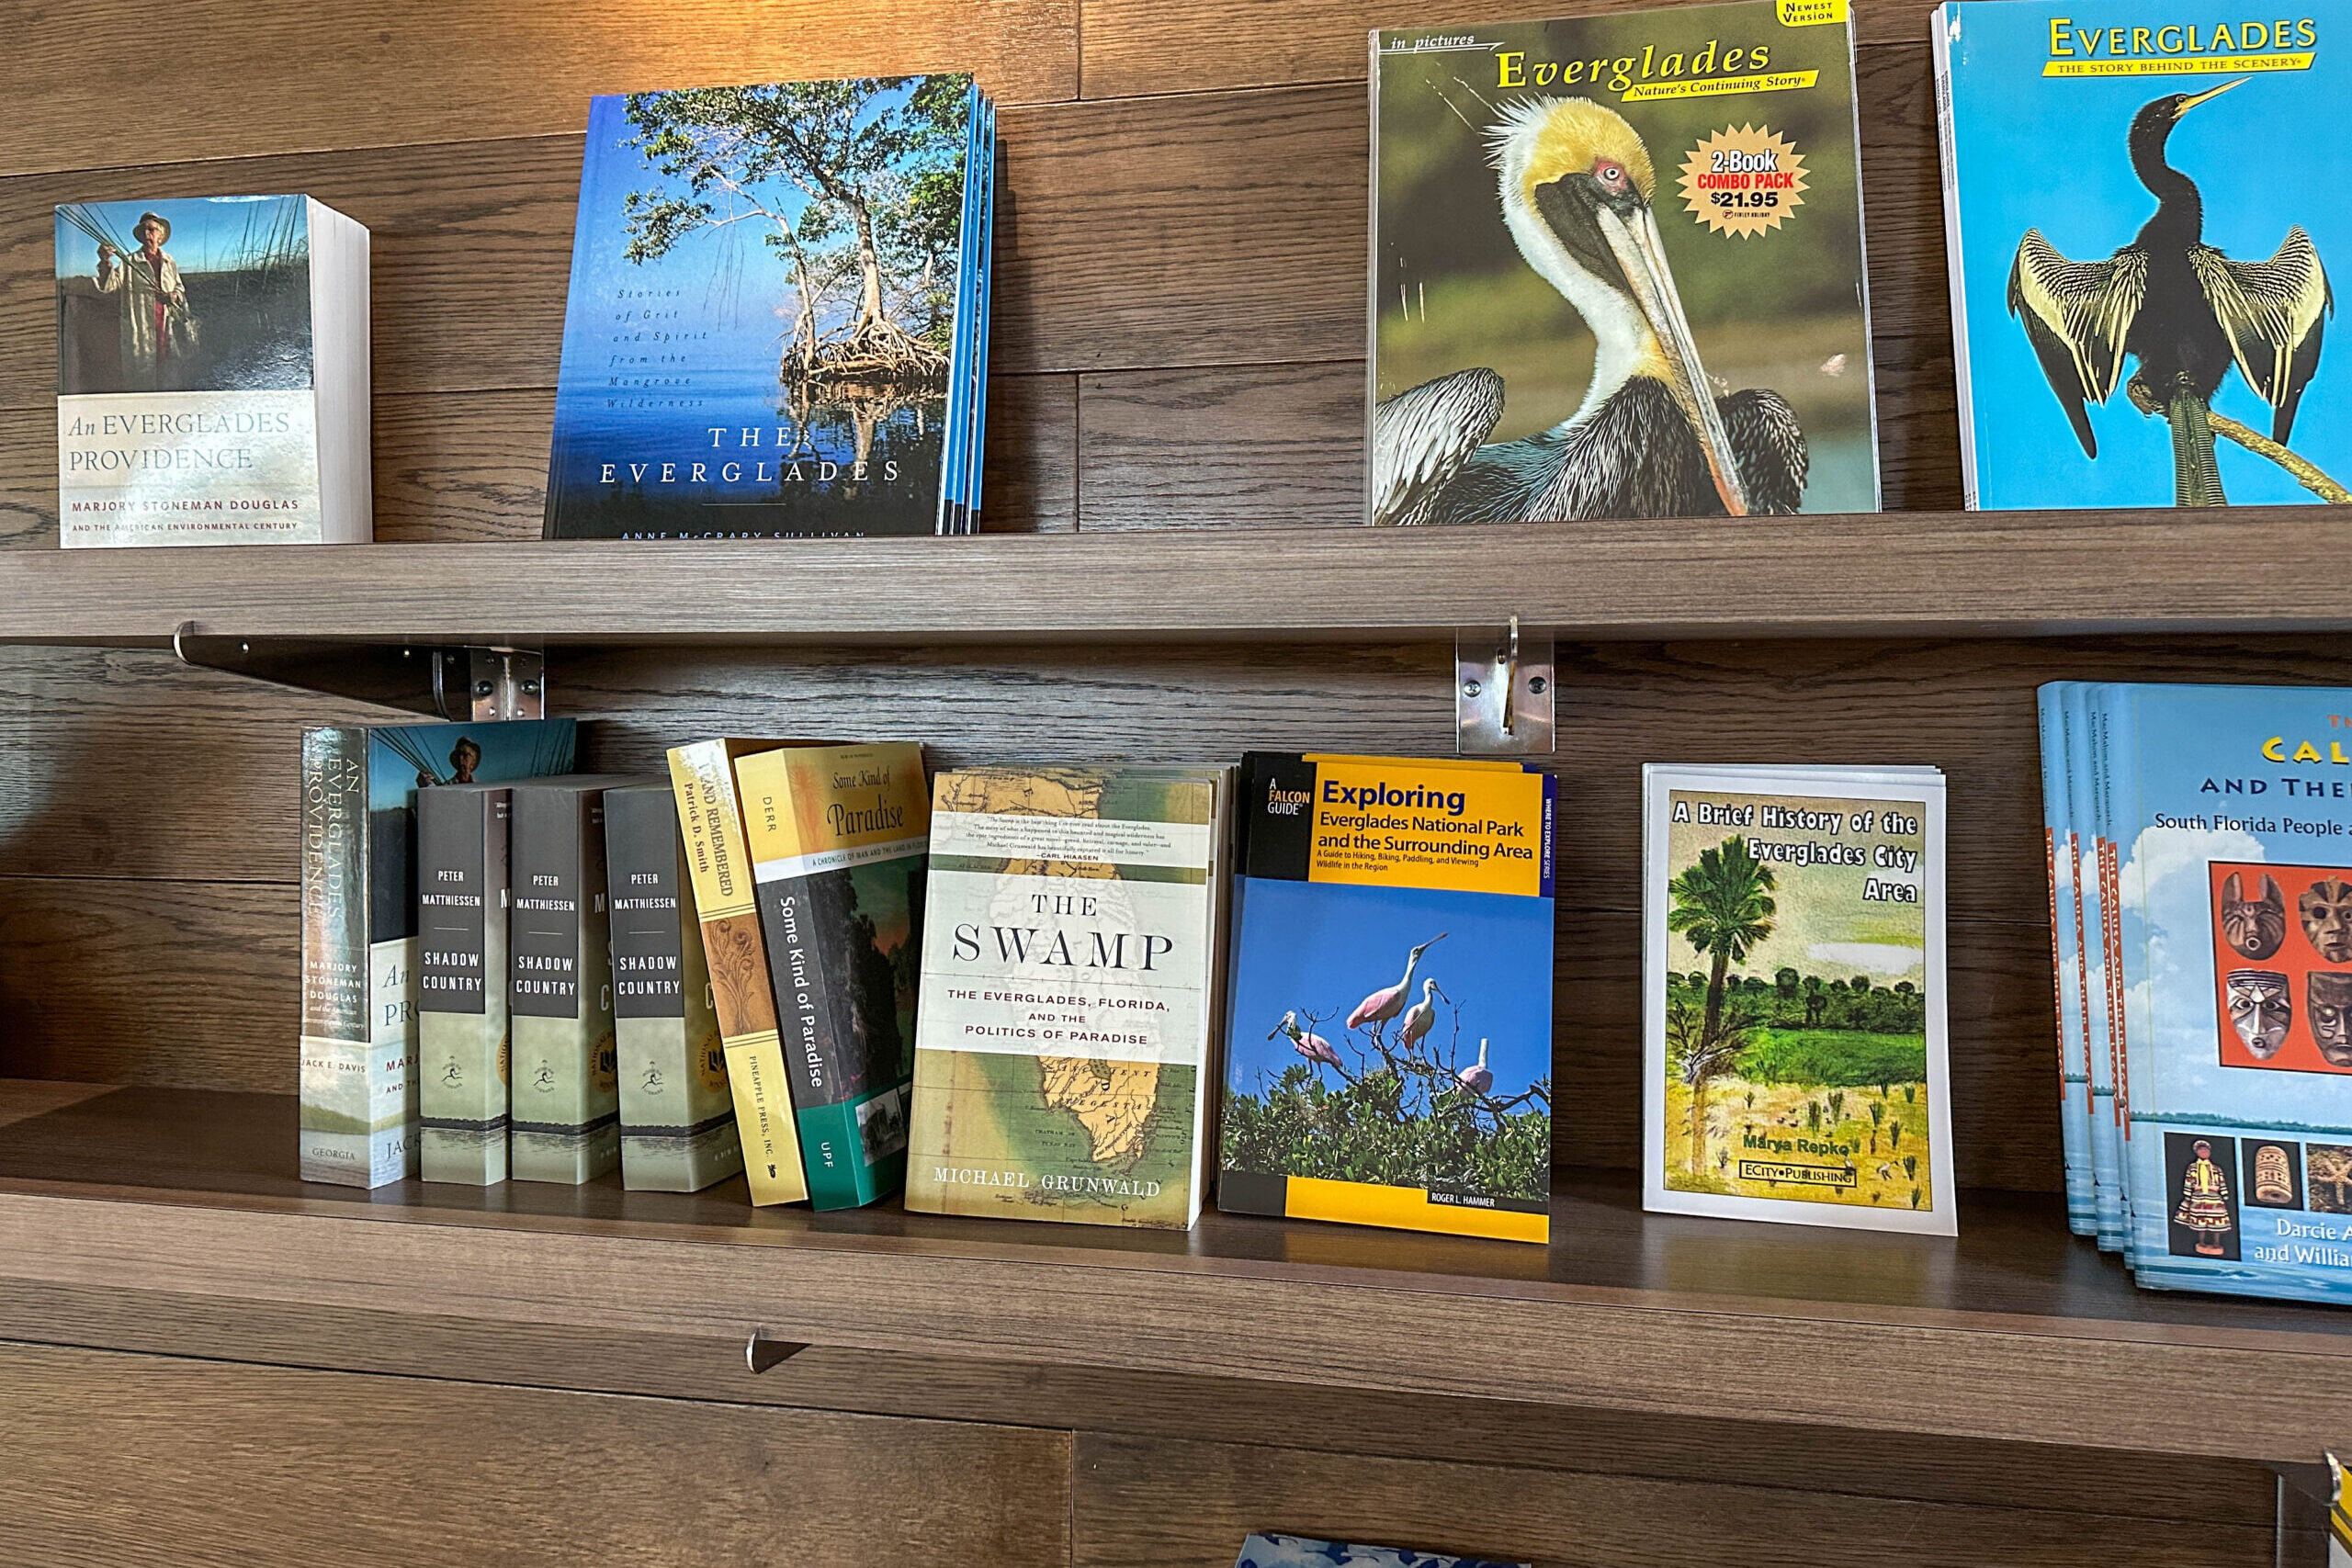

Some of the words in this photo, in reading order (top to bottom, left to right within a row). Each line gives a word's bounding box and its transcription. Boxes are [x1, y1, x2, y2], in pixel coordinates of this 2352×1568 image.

[1785, 2, 1833, 13] NEWEST
[1391, 37, 1408, 50] in
[1414, 33, 1475, 50] pictures
[2049, 17, 2316, 57] EVERGLADES
[1496, 39, 1770, 93] Everglades
[2058, 64, 2086, 74] THE
[2090, 63, 2133, 73] STORY
[2141, 62, 2193, 73] BEHIND
[2200, 60, 2227, 71] THE
[1634, 84, 1686, 98] Nature's
[1689, 77, 1761, 95] Continuing
[1711, 150, 1778, 174] 2-Book
[1698, 174, 1750, 189] COMBO
[1754, 173, 1794, 189] PACK
[1711, 191, 1779, 208] $21.95
[617, 288, 682, 299] Stories
[616, 310, 632, 323] of
[643, 310, 678, 320] Grit
[613, 333, 641, 343] and
[653, 331, 707, 344] Spirit
[609, 355, 648, 367] from
[662, 354, 686, 364] the
[609, 376, 692, 389] Mangrove
[606, 398, 704, 409] Wilderness
[69, 417, 96, 437] An
[103, 412, 290, 435] EVERGLADES
[707, 427, 791, 447] THE
[70, 448, 253, 471] PROVIDENCE
[599, 461, 899, 484] EVERGLADES
[73, 502, 136, 512] MARJORY
[142, 500, 223, 511] STONEMAN
[230, 500, 299, 511] DOUGLAS
[73, 524, 90, 532] AND
[94, 524, 111, 532] THE
[167, 522, 251, 531] ENVIRONMENTAL
[254, 522, 298, 530] CENTURY
[346, 759, 359, 793] AN
[833, 772, 855, 790] Some
[859, 765, 881, 787] Kind
[883, 765, 890, 791] of
[1269, 778, 1277, 790] A
[2199, 777, 2267, 795] AND
[684, 783, 700, 823] Patrick
[1269, 790, 1310, 804] FALCON
[1322, 780, 1465, 817] Exploring
[763, 796, 776, 832] DERR
[827, 794, 904, 837] Paradise
[1673, 801, 1690, 823] A
[1698, 801, 1754, 826] Brief
[1761, 806, 1843, 835] History
[1850, 810, 1873, 832] of
[1882, 812, 1917, 835] the
[693, 826, 702, 838] D.
[1320, 811, 1408, 833] Everglades
[1412, 817, 1483, 834] National
[1487, 820, 1524, 838] Park
[1544, 821, 1551, 829] TO
[2154, 813, 2207, 831] South
[2214, 815, 2277, 834] Florida
[2282, 817, 2343, 838] People
[309, 759, 323, 914] PROVIDENCE
[328, 758, 342, 918] EVERGLADES
[707, 808, 734, 897] REMEMBERED
[819, 854, 845, 865] CHRONICLE
[848, 853, 855, 862] OF
[870, 850, 881, 858] AND
[883, 846, 892, 854] THE
[893, 843, 906, 852] LAND
[1317, 833, 1351, 848] and
[1353, 834, 1381, 849] the
[1384, 836, 1490, 860] Surrounding
[1492, 842, 1533, 860] Area
[1748, 838, 1865, 867] Everglades
[1873, 844, 1917, 873] City
[695, 841, 709, 873] Smith
[1353, 852, 1376, 861] Hiking,
[1377, 853, 1401, 863] Biking,
[1403, 854, 1434, 864] Paddling,
[1451, 857, 1479, 867] Viewing
[1317, 860, 1342, 869] Wildlife
[1351, 862, 1363, 870] the
[1364, 863, 1388, 873] Region
[438, 871, 463, 882] PETER
[533, 875, 559, 886] PETER
[631, 874, 659, 885] PETER
[1862, 877, 1917, 903] Area
[422, 895, 481, 908] MATTHIESSEN
[516, 898, 575, 911] MATTHIESSEN
[615, 897, 676, 909] MATTHIESSEN
[1031, 895, 1097, 917] THE
[781, 896, 798, 944] Some
[953, 923, 1172, 971] SWAMP
[310, 962, 357, 973] MARJORY
[424, 952, 480, 966] SHADOW
[518, 955, 573, 971] SHADOW
[619, 956, 677, 970] SHADOW
[789, 948, 810, 987] Kind
[304, 976, 361, 988] STONEMAN
[423, 976, 481, 991] COUNTRY
[516, 980, 575, 996] COUNTRY
[618, 980, 680, 996] COUNTRY
[310, 991, 357, 1003] DOUGLAS
[797, 995, 815, 1010] of
[947, 989, 977, 1000] THE
[984, 991, 1091, 1008] EVERGLADES,
[1099, 998, 1170, 1012] FLORIDA,
[1028, 1013, 1056, 1022] AND
[1062, 1014, 1086, 1023] THE
[966, 1025, 1035, 1039] POLITICS
[1043, 1030, 1064, 1039] OF
[1070, 1031, 1148, 1044] PARADISE
[801, 1017, 823, 1088] Paradise
[301, 1059, 323, 1068] JACK
[339, 1063, 366, 1073] DAVIS
[749, 1055, 763, 1103] PINEAPPLE
[760, 1107, 770, 1136] PRESS,
[312, 1148, 356, 1160] GEORGIA
[763, 1139, 774, 1157] INC.
[1743, 1134, 1792, 1153] Marya
[1796, 1138, 1850, 1157] Repko
[820, 1142, 833, 1168] UPF
[933, 1167, 1030, 1189] MICHAEL
[1041, 1174, 1160, 1197] GRUNWALD
[1431, 1192, 1454, 1204] ROGER
[1455, 1194, 1462, 1204] L.
[1463, 1195, 1495, 1208] HAMMER
[2277, 1218, 2338, 1241] Darcie
[2254, 1245, 2290, 1263] and
